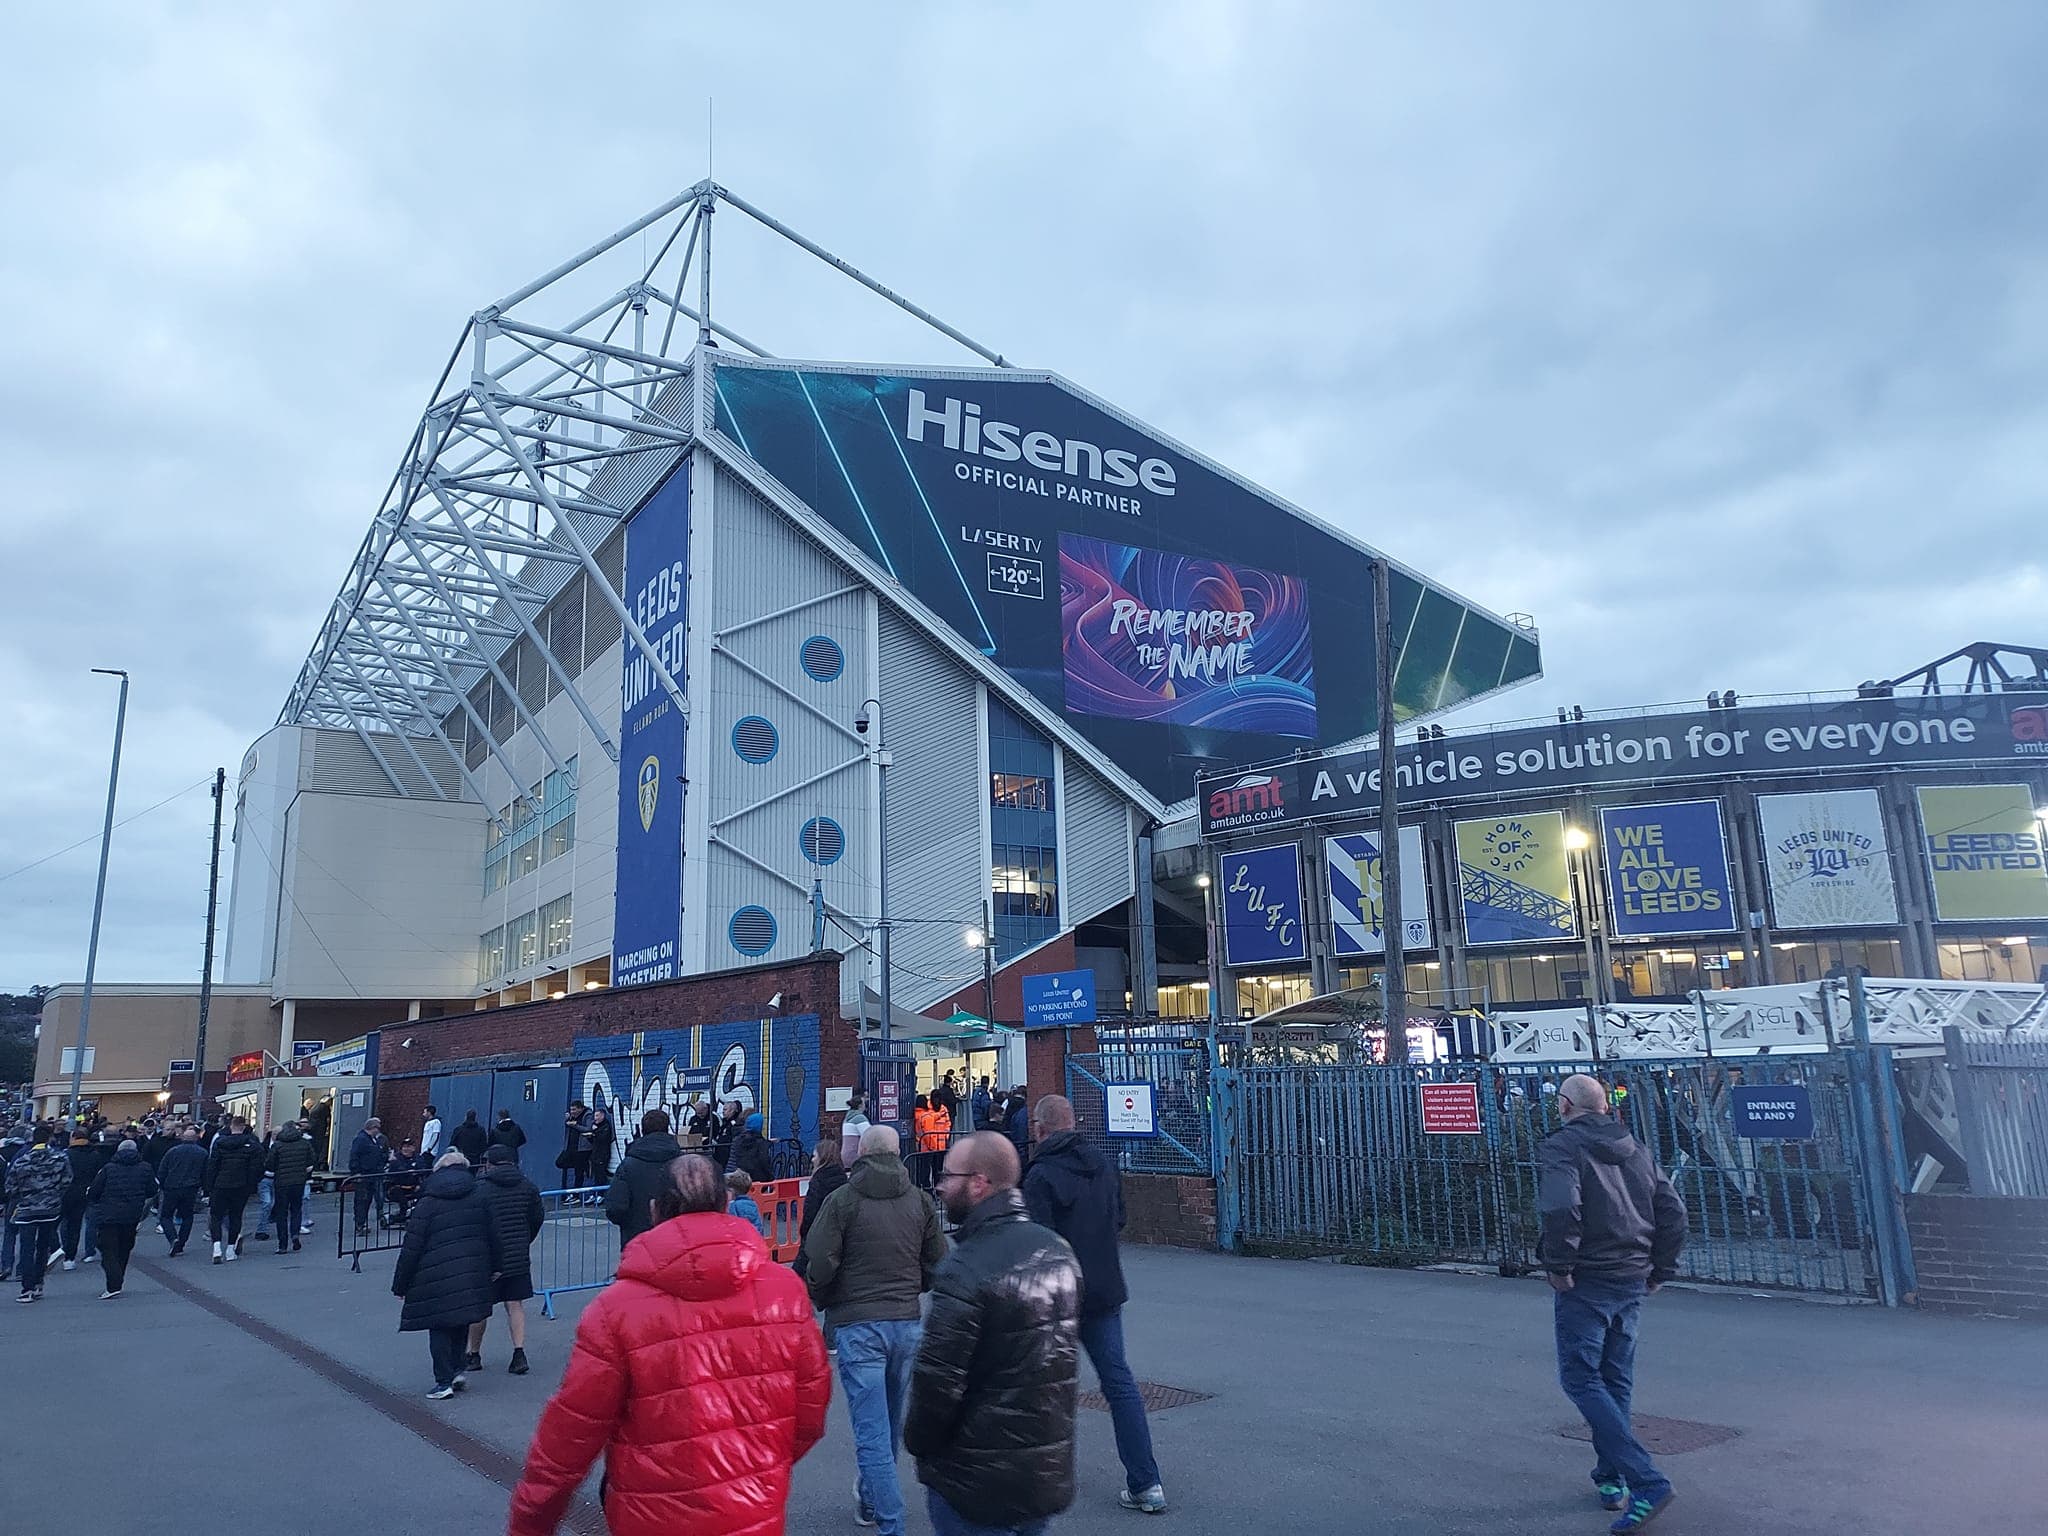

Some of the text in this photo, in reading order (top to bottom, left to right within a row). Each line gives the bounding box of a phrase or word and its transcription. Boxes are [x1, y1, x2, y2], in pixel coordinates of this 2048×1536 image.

[907, 388, 1177, 496] Hisense
[954, 462, 1142, 516] OFFICIAL PARTNER
[961, 526, 1042, 554] LASER TV
[1110, 599, 1255, 647] REMEMBER
[1136, 643, 1255, 695] THE NAME
[1311, 770, 1339, 801] A
[1345, 750, 1483, 795] vehicle
[1495, 732, 1672, 777] solution
[1685, 725, 1751, 759] for
[1764, 716, 1977, 756] everyone
[1210, 776, 1285, 818] amt
[1210, 807, 1285, 829] amtauto.co.uk
[1485, 822, 1533, 843] HOME
[1614, 824, 1664, 847] WE
[1777, 829, 1872, 854] LEEDS UNITED
[1927, 832, 2038, 853] LEEDS
[1353, 851, 1380, 859] ESTABLI
[1498, 841, 1521, 853] OF
[1490, 853, 1533, 871] LUFC
[1618, 847, 1674, 870] ALL
[1788, 861, 1803, 870] 19
[1854, 858, 1869, 866] 19
[1932, 853, 2041, 871] UNITED
[1621, 867, 1702, 892] LOVE
[1624, 889, 1721, 915] LEEDS
[618, 940, 673, 971] MARCHING ON
[1039, 1002, 1063, 1011] PARKING
[1063, 1000, 1088, 1009] BEYOND
[1042, 1012, 1073, 1021] THIS POINT
[1757, 1007, 1791, 1025] SGL
[1543, 1027, 1569, 1043] SGL
[1747, 1102, 1797, 1110] ENTRANCE
[1748, 1112, 1795, 1120] 8A AND 9
